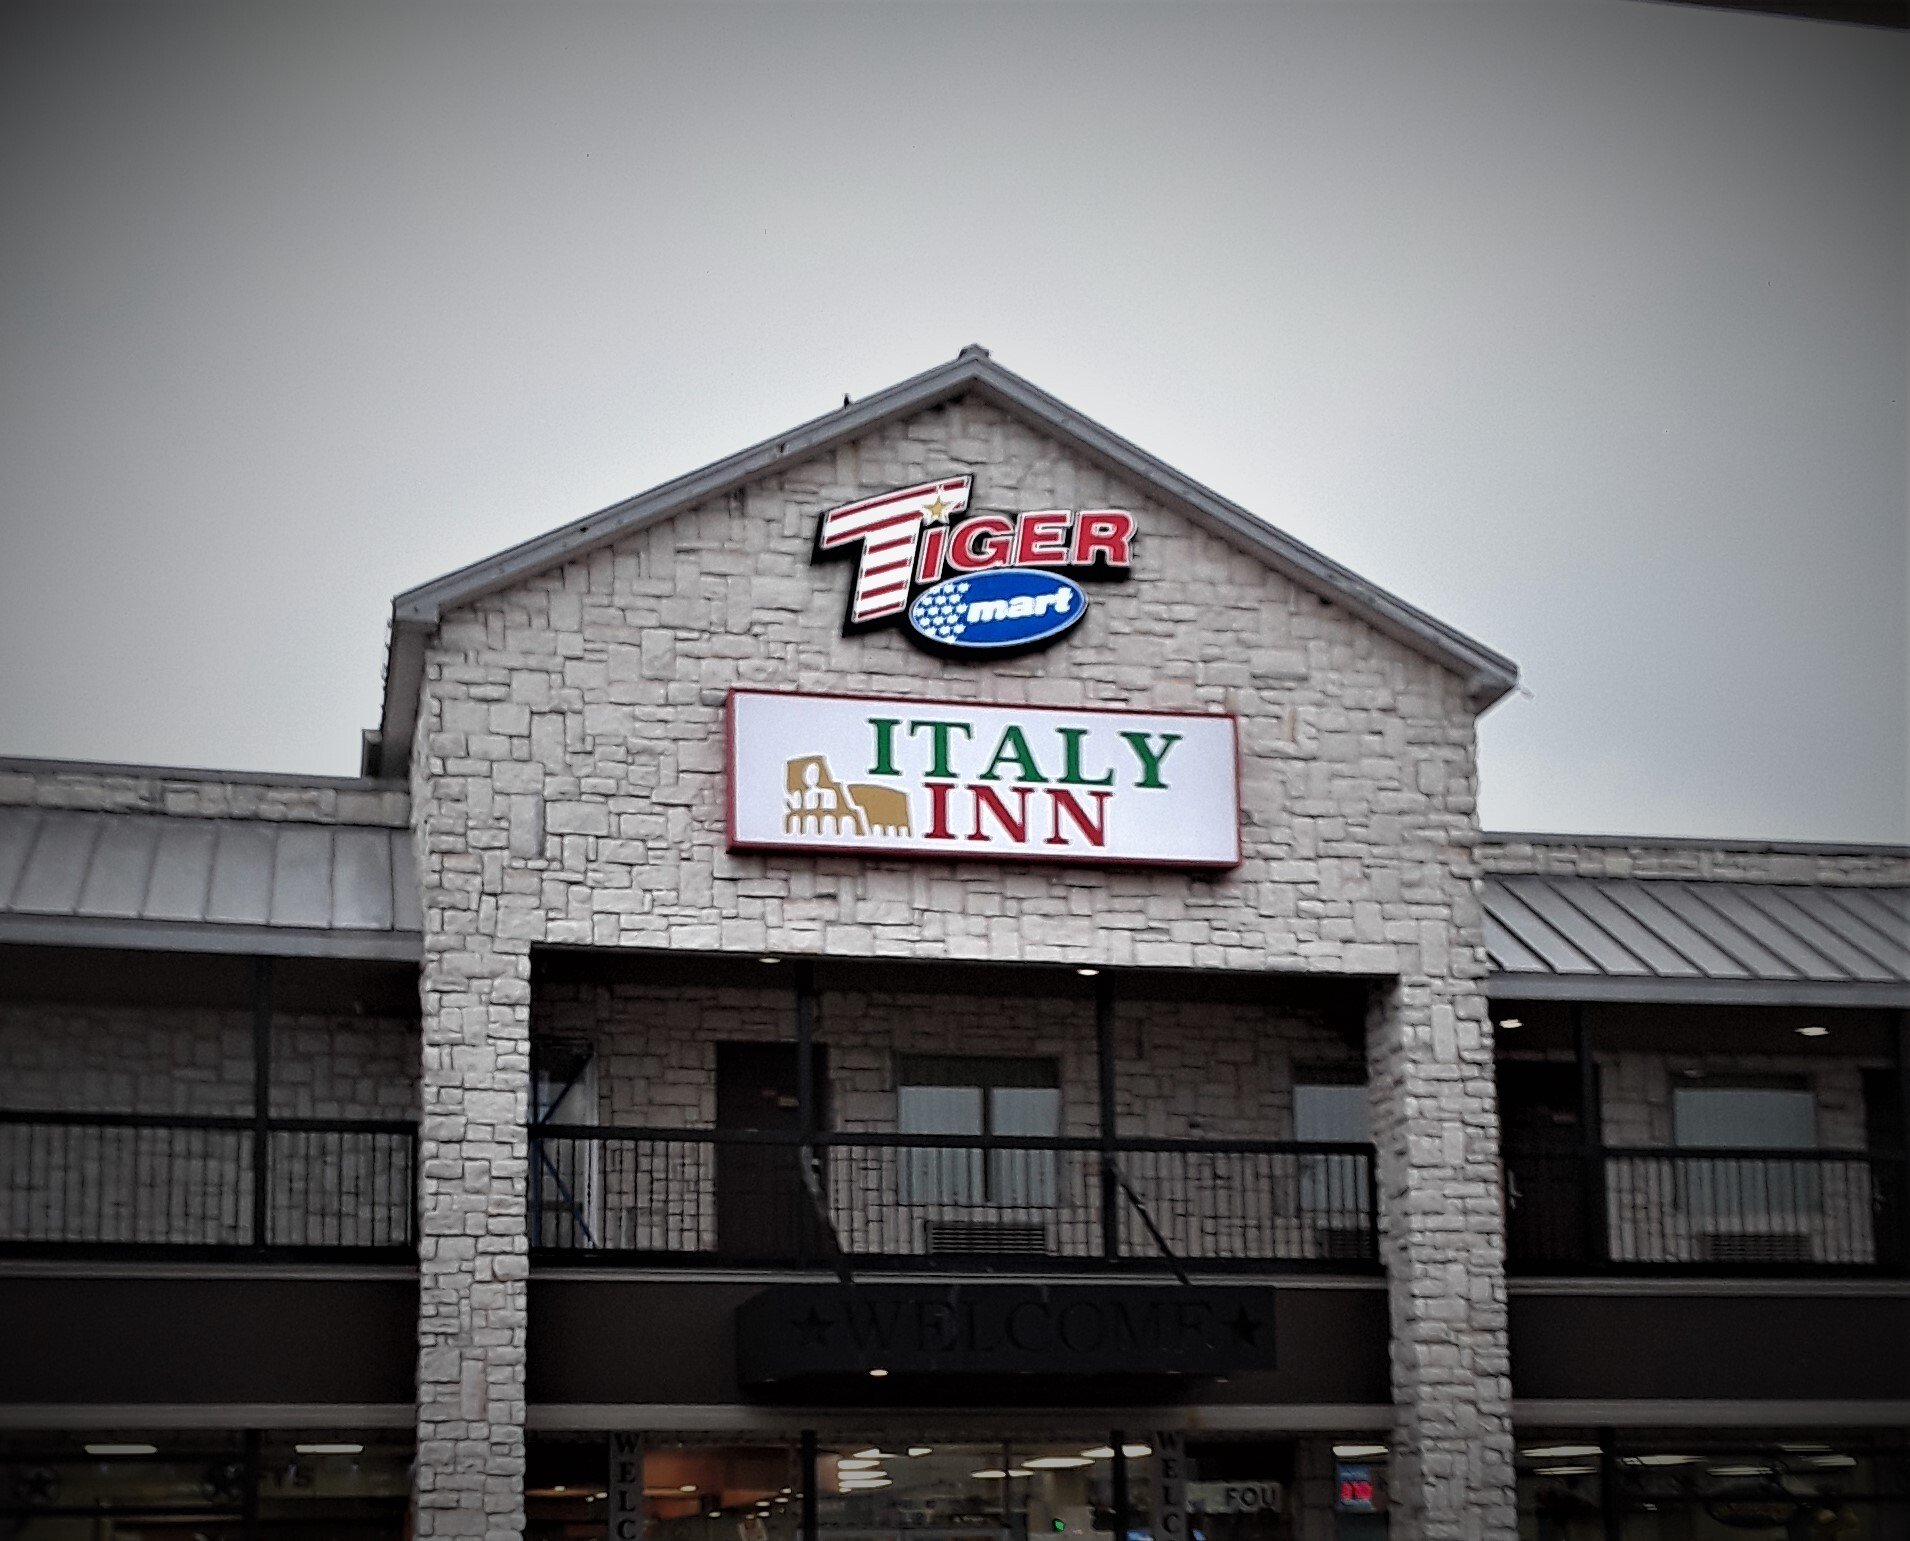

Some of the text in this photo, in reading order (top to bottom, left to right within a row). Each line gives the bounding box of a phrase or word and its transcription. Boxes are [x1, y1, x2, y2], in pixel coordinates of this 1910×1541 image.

[820, 475, 1138, 622] TIGER
[966, 586, 1074, 624] mart
[868, 718, 1183, 789] ITALY
[923, 782, 1114, 846] INN
[844, 1300, 1212, 1353] WELCOME
